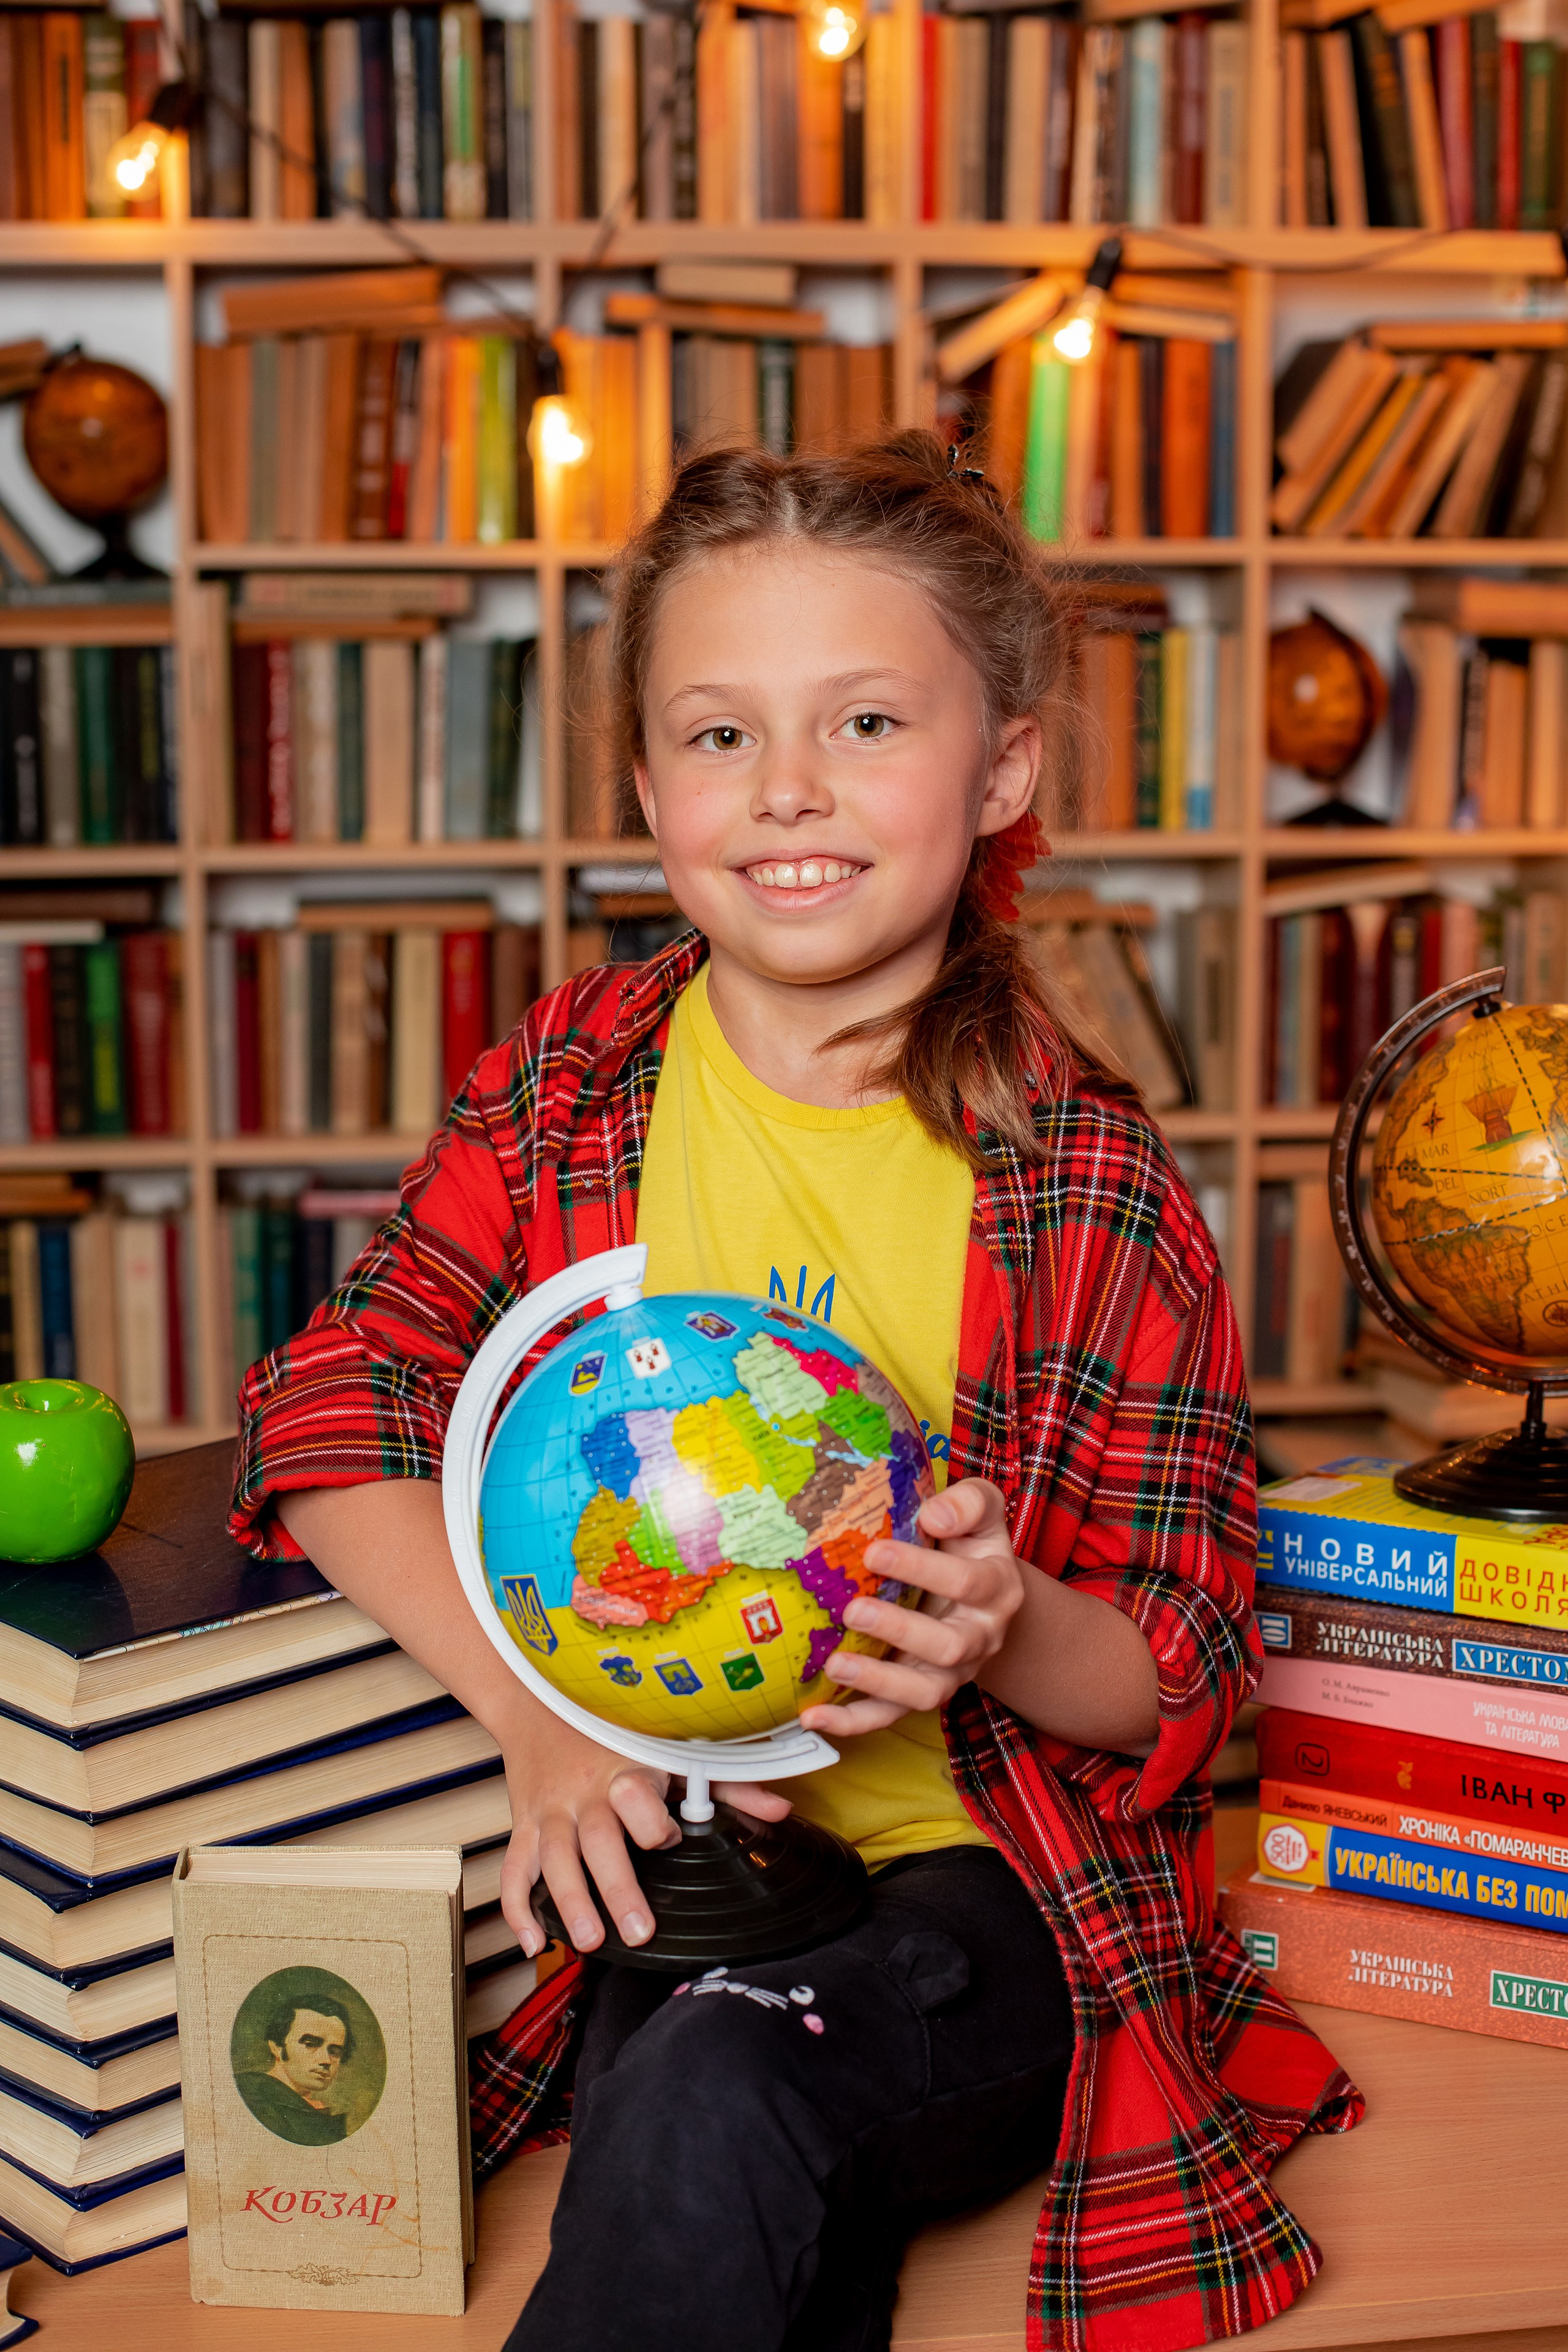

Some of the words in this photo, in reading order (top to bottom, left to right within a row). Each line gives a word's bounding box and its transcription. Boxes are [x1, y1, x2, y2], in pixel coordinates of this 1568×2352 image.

[1434, 1176, 1460, 1194] DEL
[1284, 1532, 1447, 1578] НОВИЙ
[1285, 1556, 1447, 1598] УНІВЕРСАЛЬНИЙ
[1261, 1617, 1287, 1643] 10
[1316, 1636, 1444, 1668] ЛІТЕРАТУРА
[1460, 1646, 1568, 1682] ХРЕСТО
[1484, 1721, 1498, 1736] ТА
[1501, 1724, 1560, 1749] ЛІТЕРАТУРА
[1302, 1751, 1324, 1768] 2
[1461, 1774, 1533, 1809] ІВАН
[1399, 1815, 1461, 1845] ХРОНІКА
[1335, 1847, 1470, 1899] УКРАЇНСЬКА
[1476, 1874, 1518, 1909] БЕЗ
[1348, 1966, 1453, 1998] ЛІТЕРАТУРА
[239, 2185, 397, 2226] КОБЗАР
